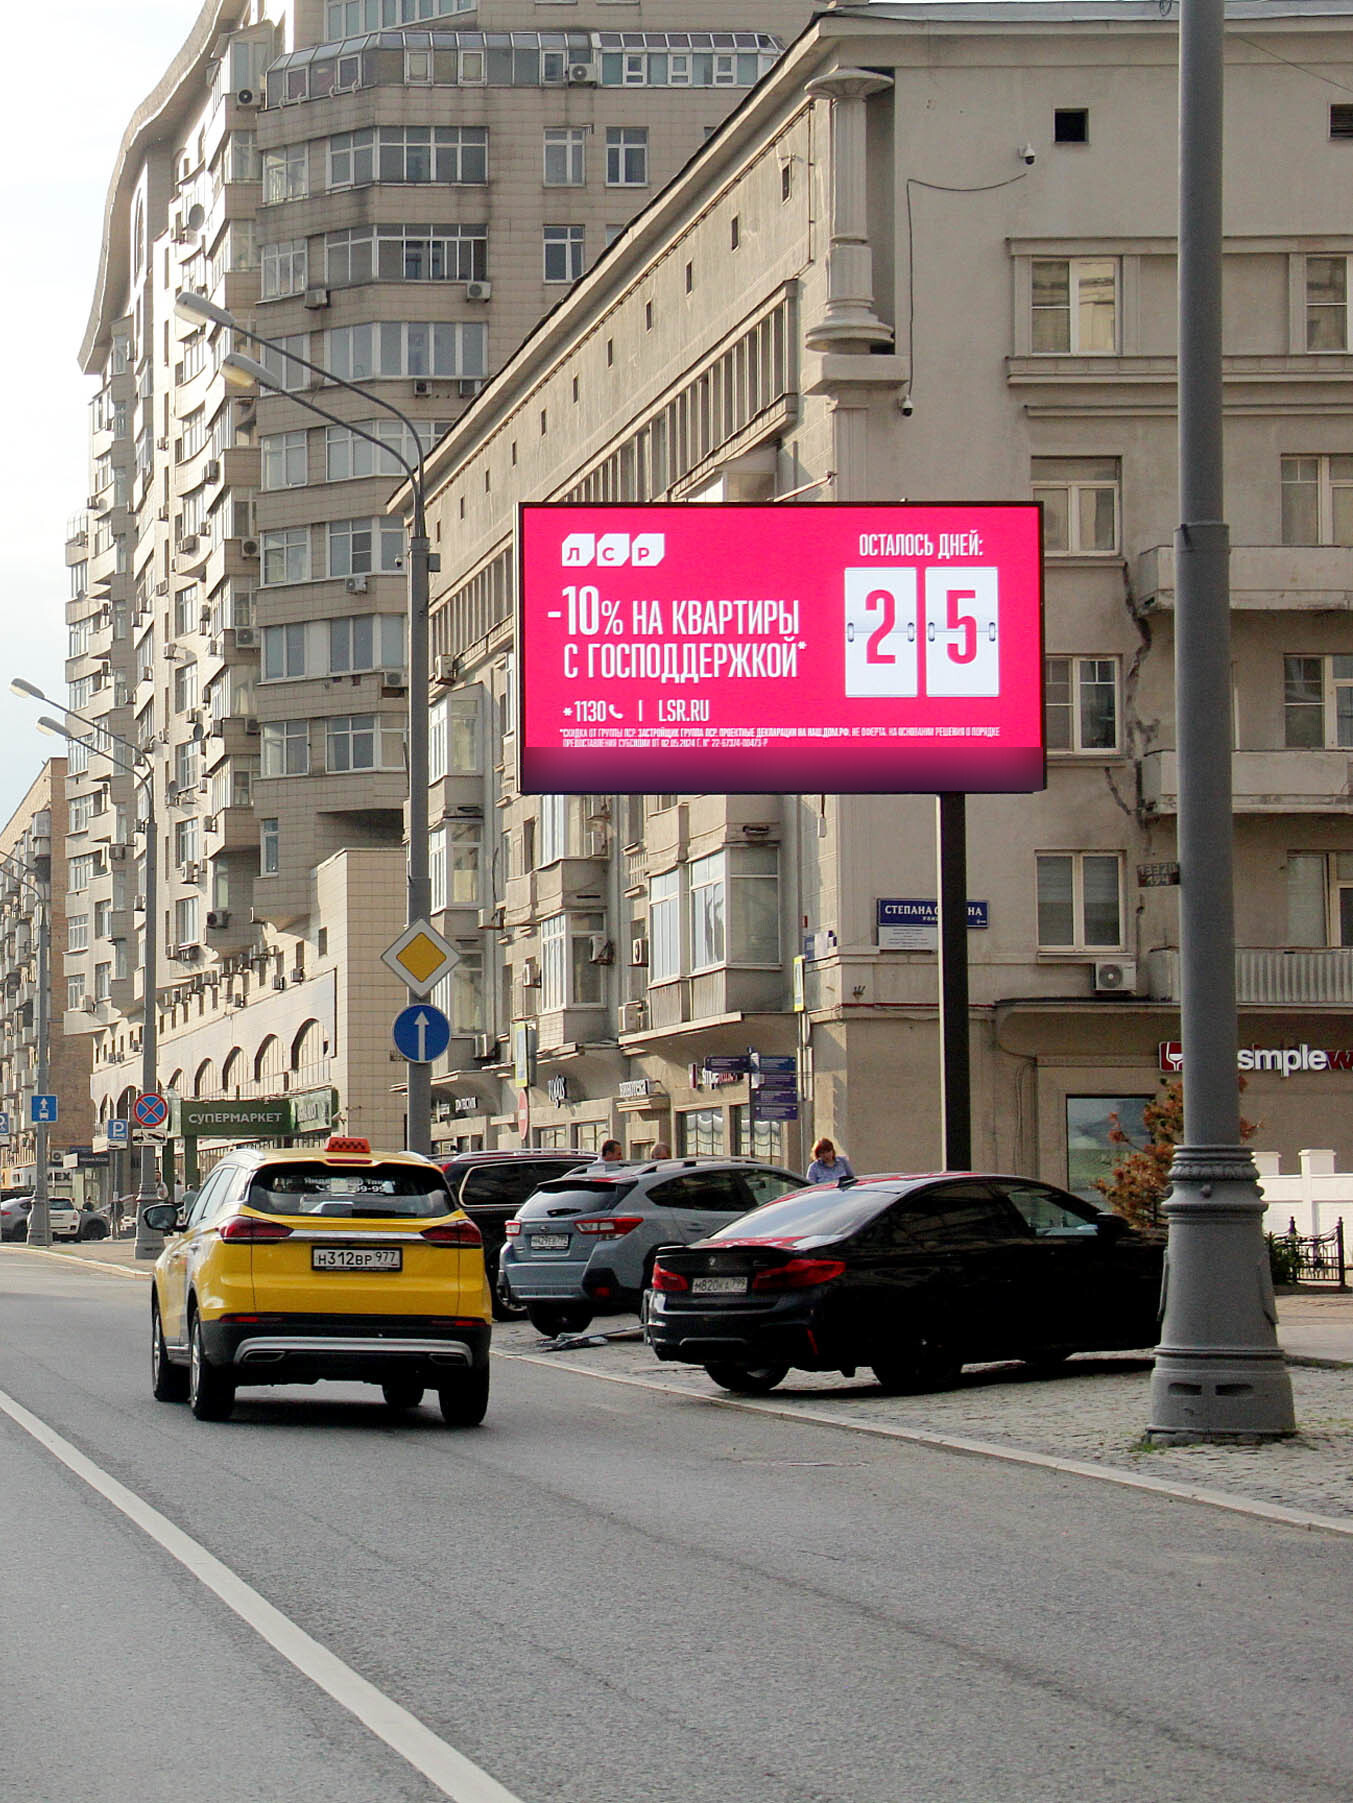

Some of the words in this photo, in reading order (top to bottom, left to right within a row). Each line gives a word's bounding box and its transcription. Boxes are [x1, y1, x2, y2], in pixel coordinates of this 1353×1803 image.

[858, 533, 935, 557] ОСТАЛОСЬ
[937, 529, 984, 560] ДНЕЙ:
[547, 585, 624, 636] -10%
[631, 600, 664, 636] НА
[671, 600, 800, 636] КВАРТИРЫ
[563, 642, 579, 679] С
[658, 699, 710, 722] LSR.RU
[884, 904, 931, 915] СТЕПАНА
[188, 1112, 283, 1124] СУПЕРМАРКЕТ
[318, 1251, 373, 1265] Н312ВР
[375, 1251, 396, 1262] 977
